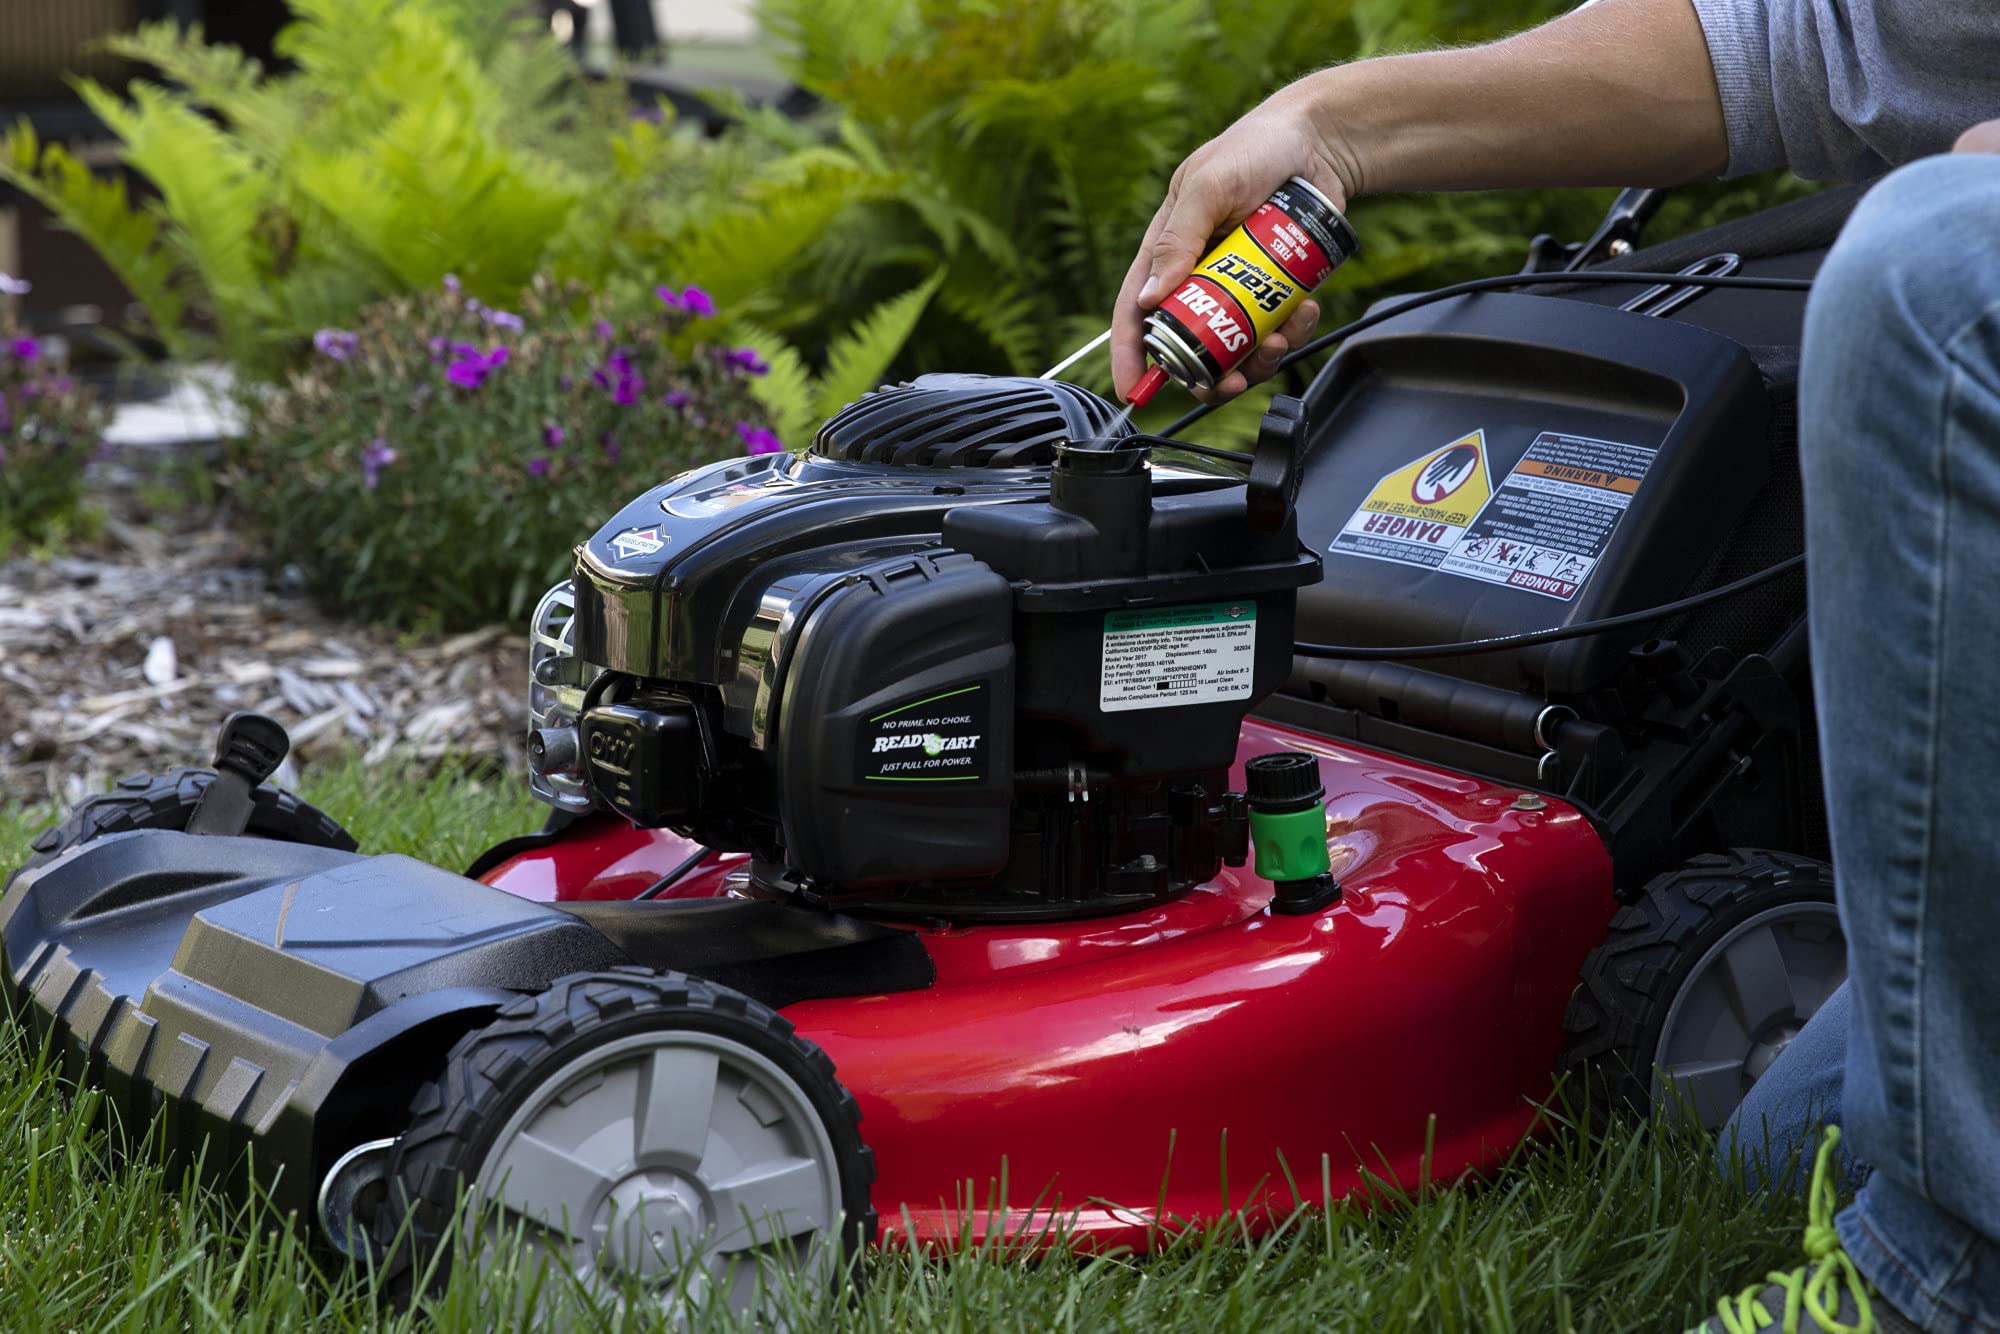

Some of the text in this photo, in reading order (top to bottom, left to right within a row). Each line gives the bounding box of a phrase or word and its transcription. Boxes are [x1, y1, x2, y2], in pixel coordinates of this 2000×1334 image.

[1286, 222, 1309, 245] ENGINES
[1270, 238, 1293, 262] FIXES
[1206, 257, 1288, 312] Start!
[1273, 278, 1295, 295] Your
[1176, 282, 1248, 352] STA-BIL
[1542, 464, 1601, 483] WARNING
[1367, 500, 1389, 510] AWAY
[1387, 503, 1409, 514] FEET
[1419, 507, 1446, 520] HANDS
[1447, 512, 1468, 524] KEEP
[1363, 514, 1448, 543] DANGER
[1511, 571, 1560, 592] DANGER
[1173, 615, 1214, 624] CORPORATION
[1166, 649, 1201, 658] Displacement:
[1129, 692, 1158, 701] Compliance
[883, 721, 896, 730] NO
[898, 719, 924, 728] PRIME.
[941, 715, 971, 724] CHOKE.
[880, 757, 972, 773] JUST PULL FOR POWER.
